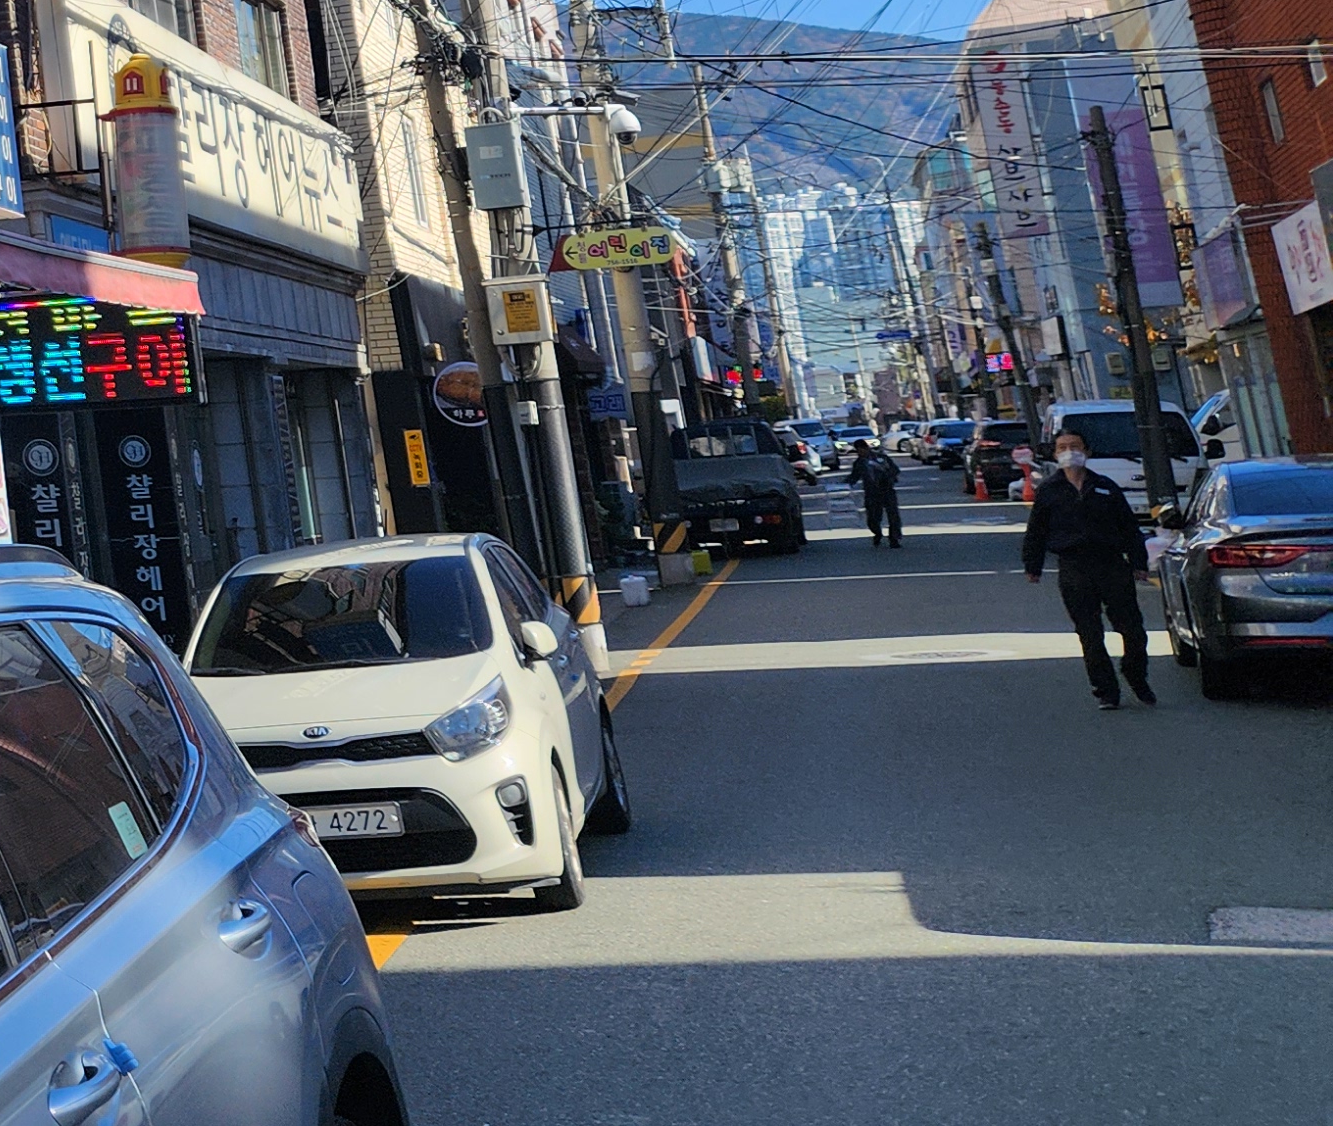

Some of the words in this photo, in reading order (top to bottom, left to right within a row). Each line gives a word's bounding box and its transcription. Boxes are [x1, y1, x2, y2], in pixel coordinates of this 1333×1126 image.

[587, 233, 671, 259] 어린이집
[306, 727, 328, 736] KIA
[329, 809, 389, 833] 4272
